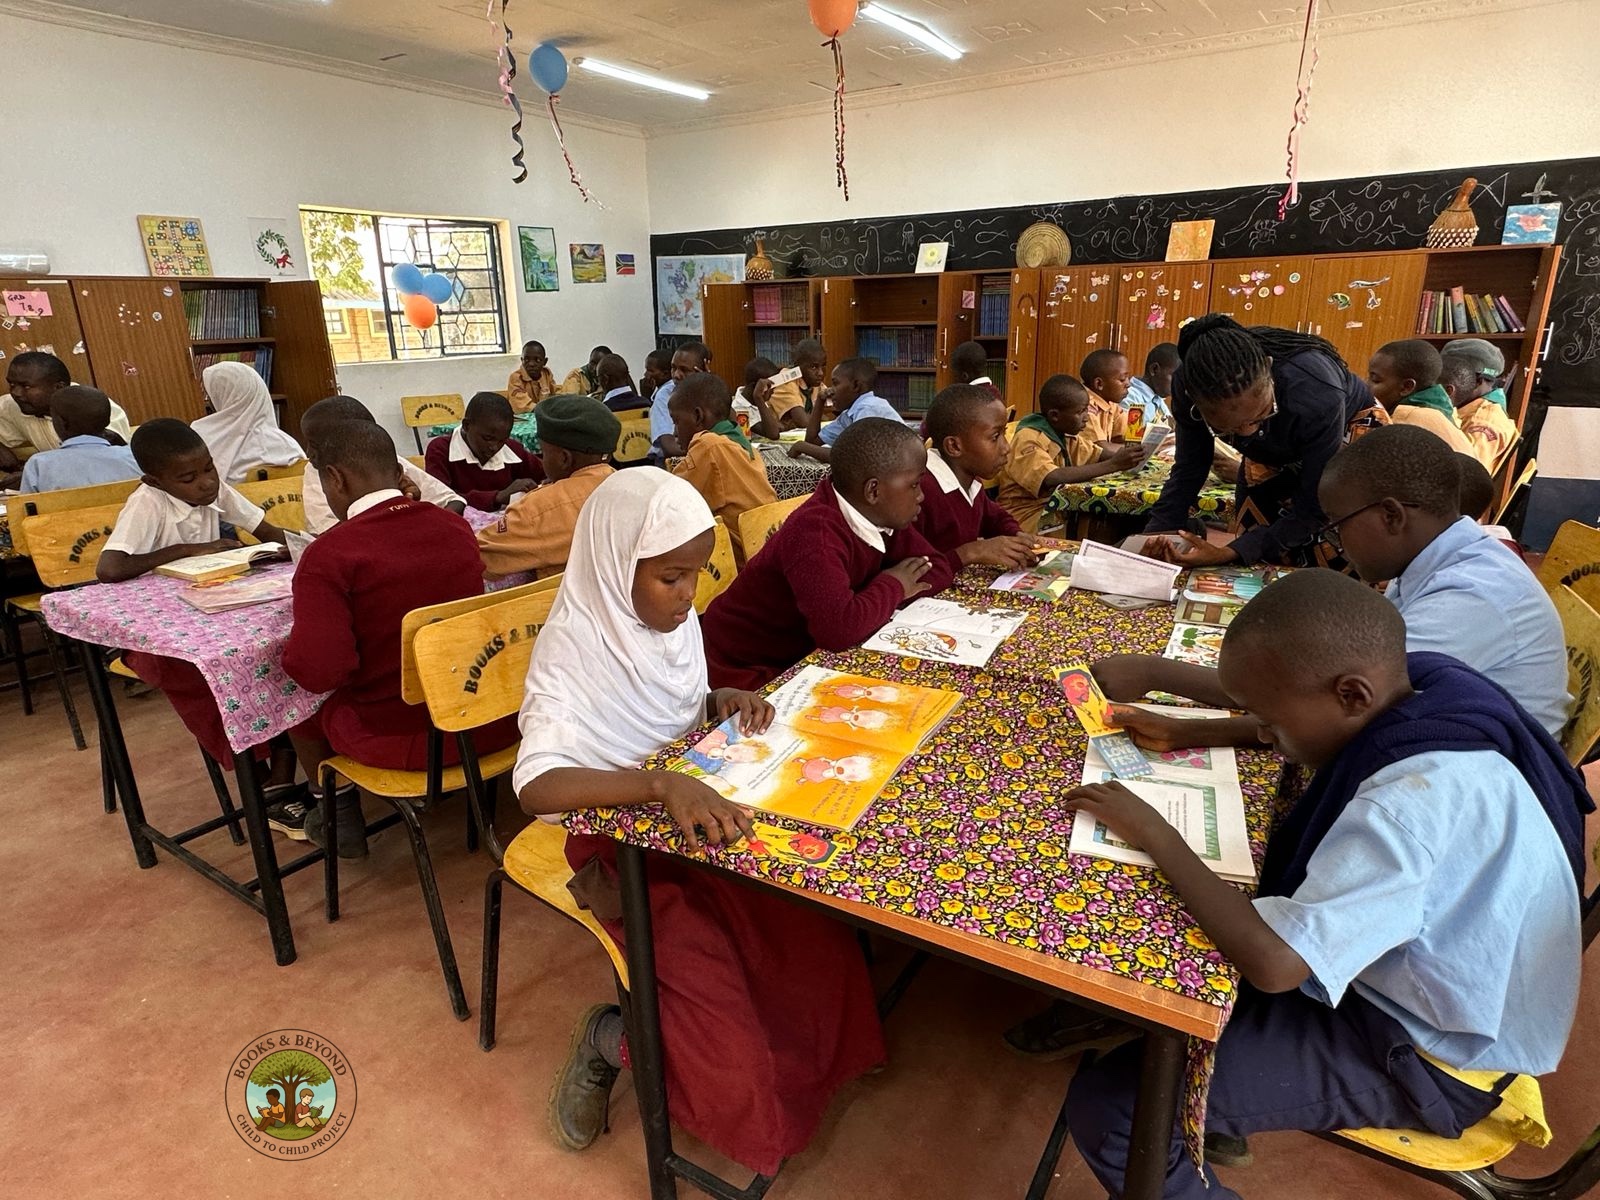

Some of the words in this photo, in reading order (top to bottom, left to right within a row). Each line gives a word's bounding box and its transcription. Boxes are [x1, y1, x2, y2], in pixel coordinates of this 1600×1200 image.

[277, 494, 285, 504] &
[69, 528, 101, 564] BOOKS
[463, 633, 505, 695] BOOKS
[508, 628, 521, 644] &
[1103, 743, 1135, 758] LOVE
[1110, 753, 1140, 768] FEST
